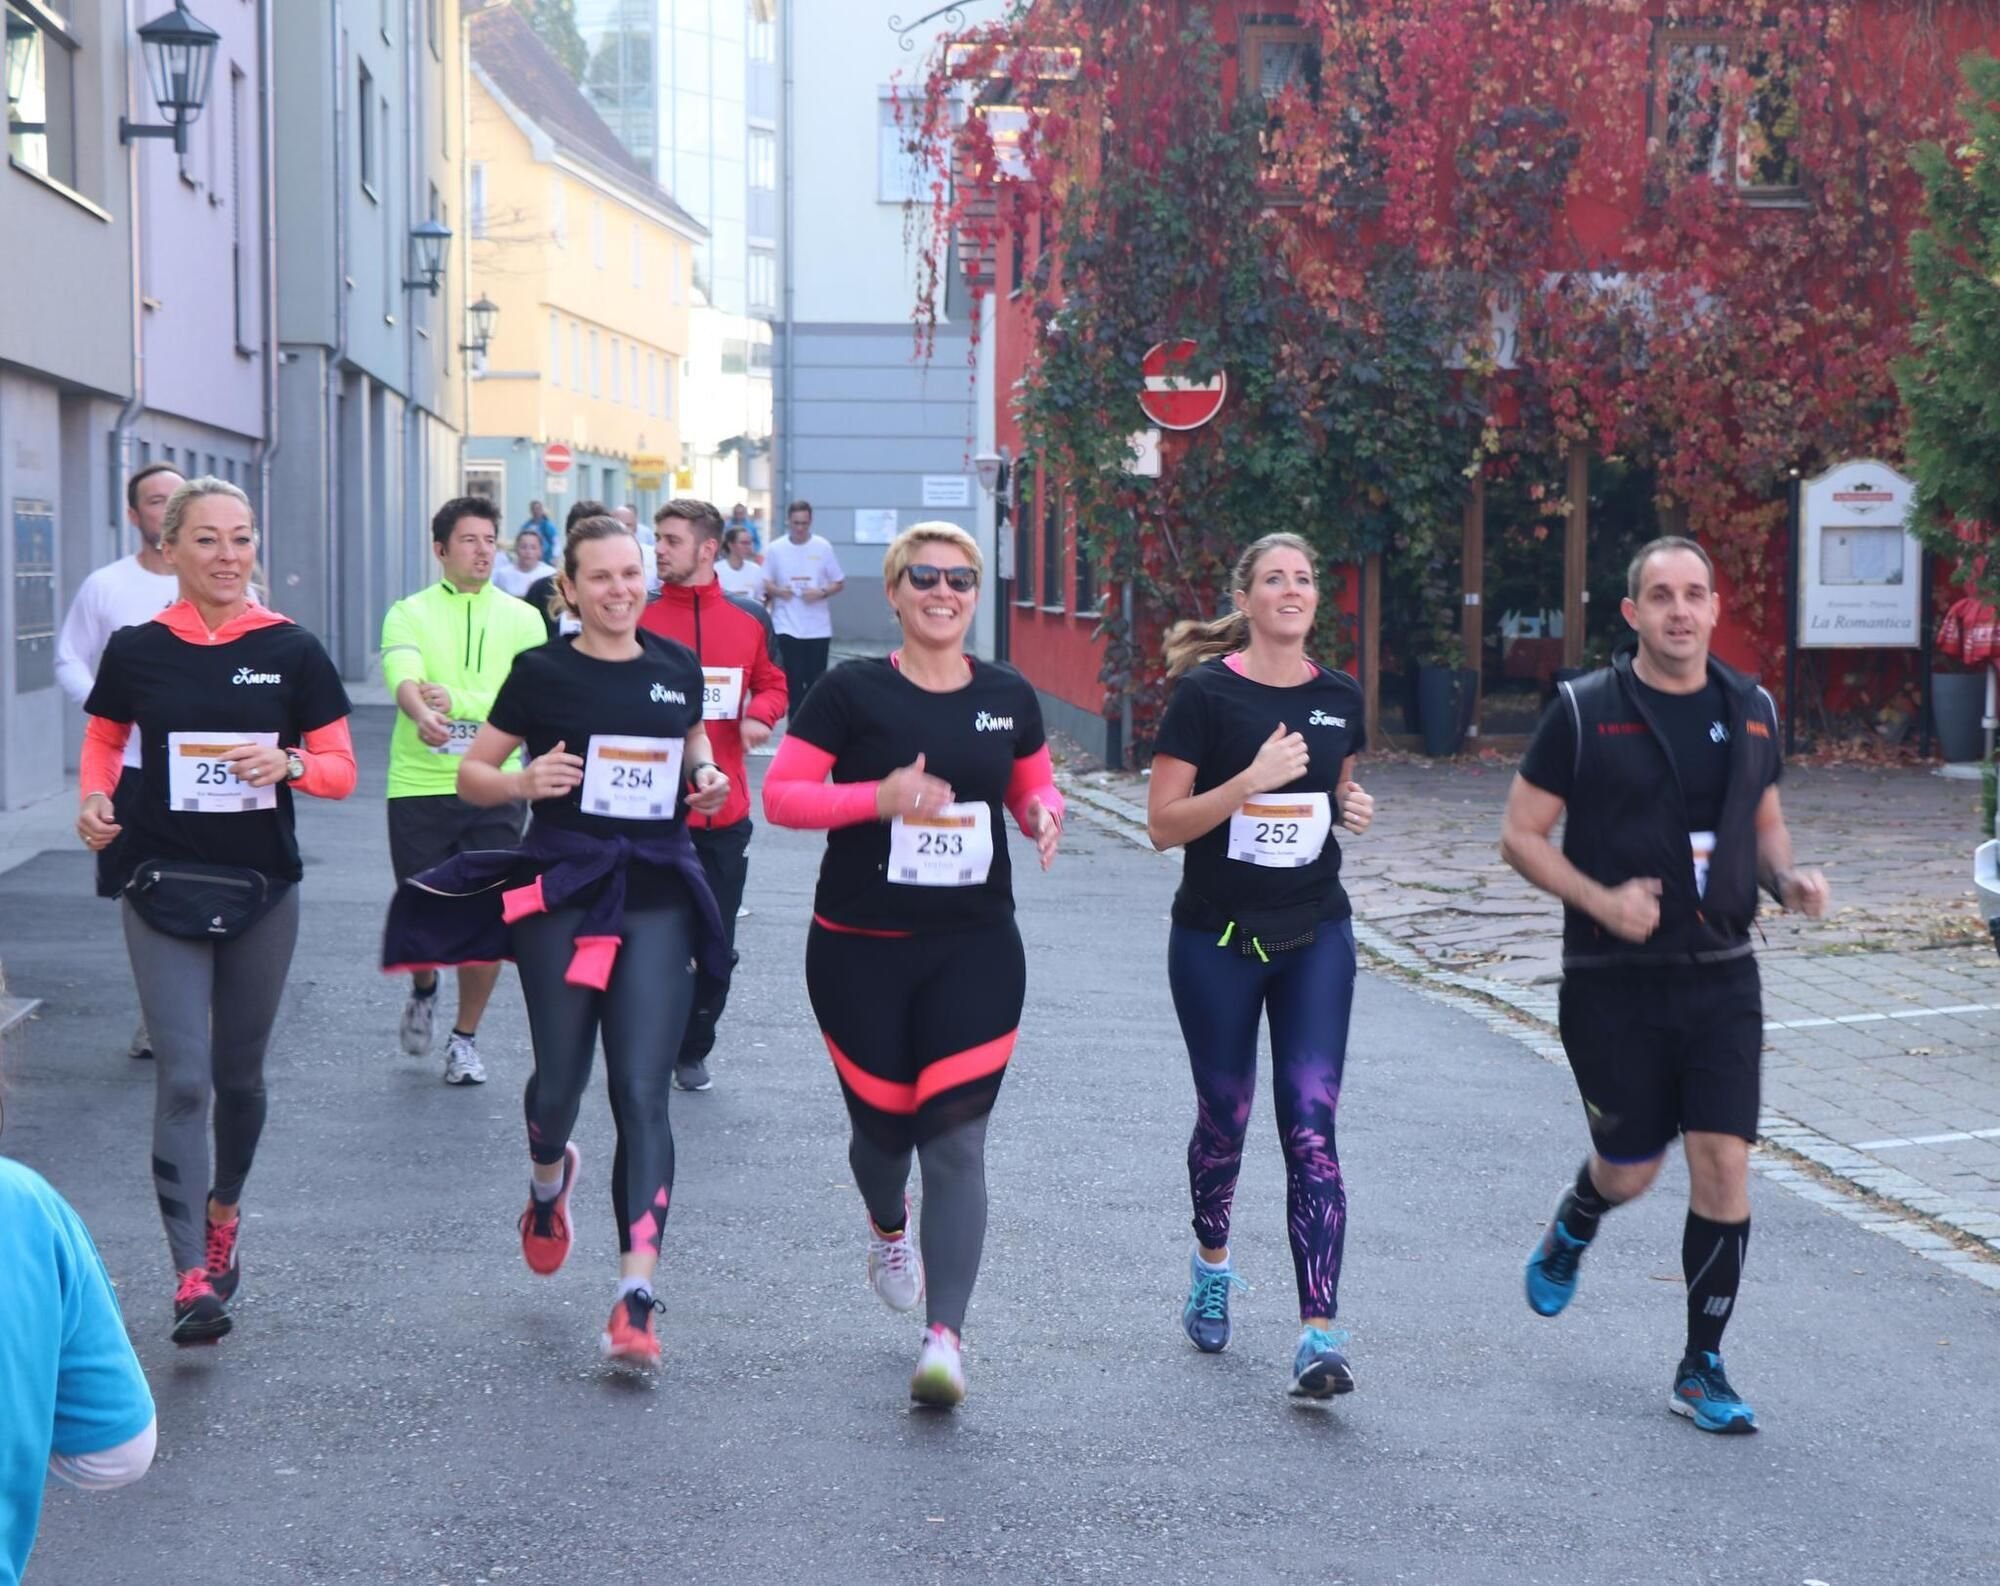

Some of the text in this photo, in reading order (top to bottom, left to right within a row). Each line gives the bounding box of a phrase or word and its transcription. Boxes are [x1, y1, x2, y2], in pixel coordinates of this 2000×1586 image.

[1811, 613, 1911, 629] La Romantica
[233, 667, 281, 685] CAMPUS
[447, 724, 478, 739] 233
[611, 766, 653, 788] 254
[1255, 823, 1298, 844] 252
[917, 832, 963, 855] 253
